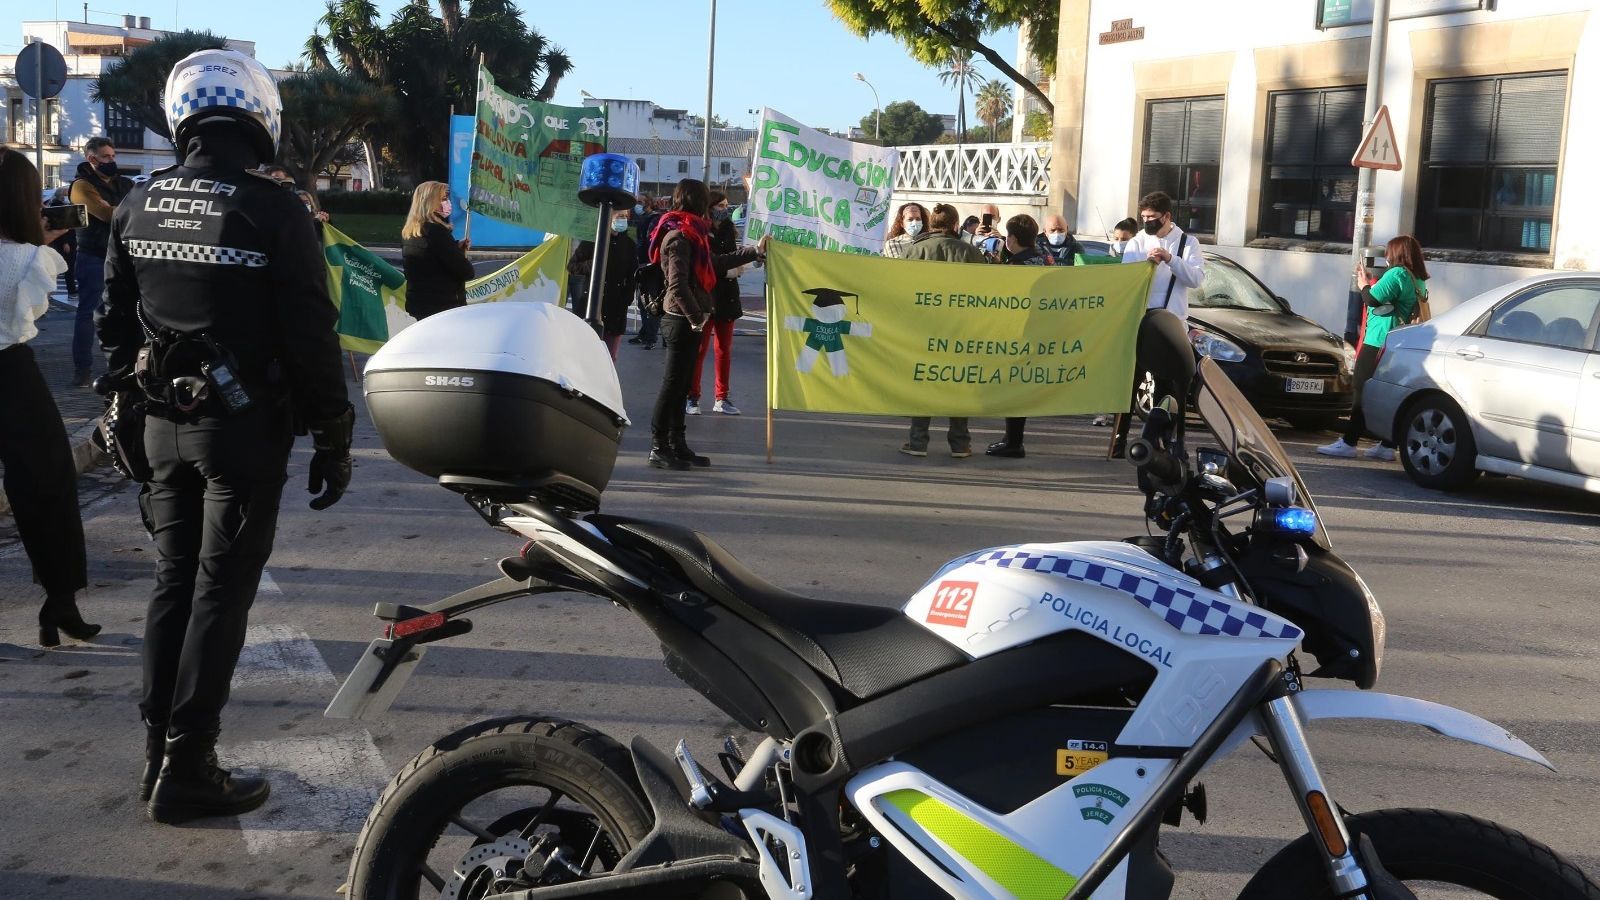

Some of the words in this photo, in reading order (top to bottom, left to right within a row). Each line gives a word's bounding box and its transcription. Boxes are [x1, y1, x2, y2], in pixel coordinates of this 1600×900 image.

[182, 70, 196, 80] PL
[199, 65, 238, 77] JEREZ
[544, 115, 570, 131] QUE
[147, 177, 237, 197] POLICIA
[143, 196, 223, 216] LOCAL
[158, 218, 202, 230] JEREZ
[465, 282, 491, 299] NANDO
[489, 268, 520, 293] SAVATER
[914, 292, 942, 307] IES
[949, 294, 1031, 310] FERNANDO
[1038, 296, 1105, 310] SAVATER
[928, 337, 949, 353] EN
[954, 340, 1030, 356] DEFENSA
[1037, 341, 1057, 355] DE
[1062, 339, 1083, 354] LA
[913, 362, 1001, 384] ESCUELA
[1009, 360, 1086, 384] PÚBLICA
[425, 375, 475, 387] SH45
[935, 586, 974, 611] 112
[1039, 591, 1109, 636] POLICIA
[1113, 625, 1174, 669] LOCAL
[1084, 742, 1105, 751] 14.4
[1064, 755, 1075, 770] 5
[1075, 756, 1100, 766] YEAR
[1075, 786, 1102, 794] POLICIA
[1103, 788, 1124, 803] LOCAL
[1085, 810, 1109, 821] JEREZ
